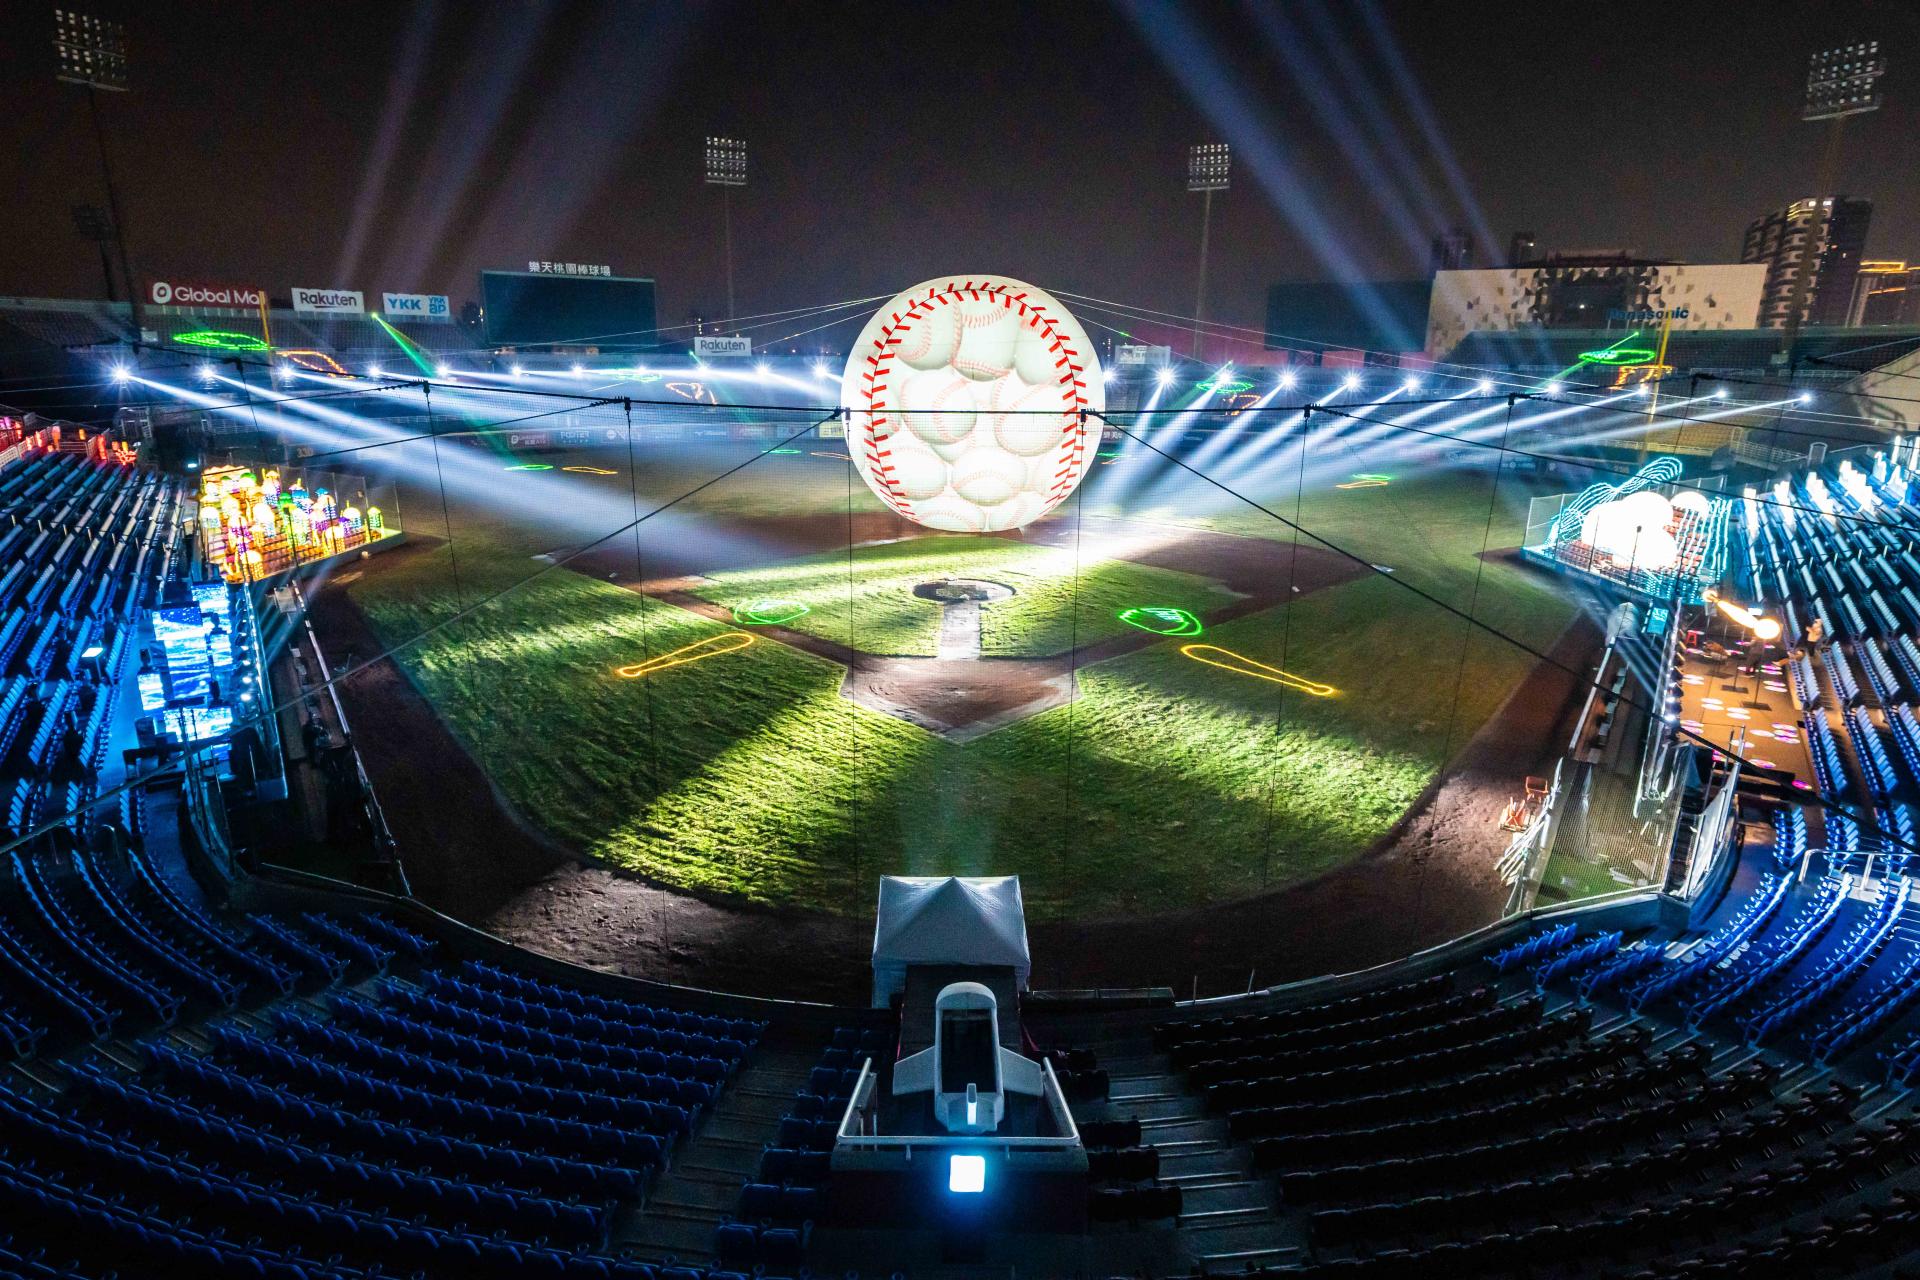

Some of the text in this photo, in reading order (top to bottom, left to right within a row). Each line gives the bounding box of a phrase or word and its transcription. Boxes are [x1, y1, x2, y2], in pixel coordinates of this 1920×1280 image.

[528, 261, 611, 276] 樂天桃園棒球場
[174, 286, 231, 304] Global
[299, 291, 358, 308] Rakuten
[388, 297, 422, 311] YKK
[1607, 306, 1689, 320] Panasonic
[700, 339, 746, 351] Rakuten
